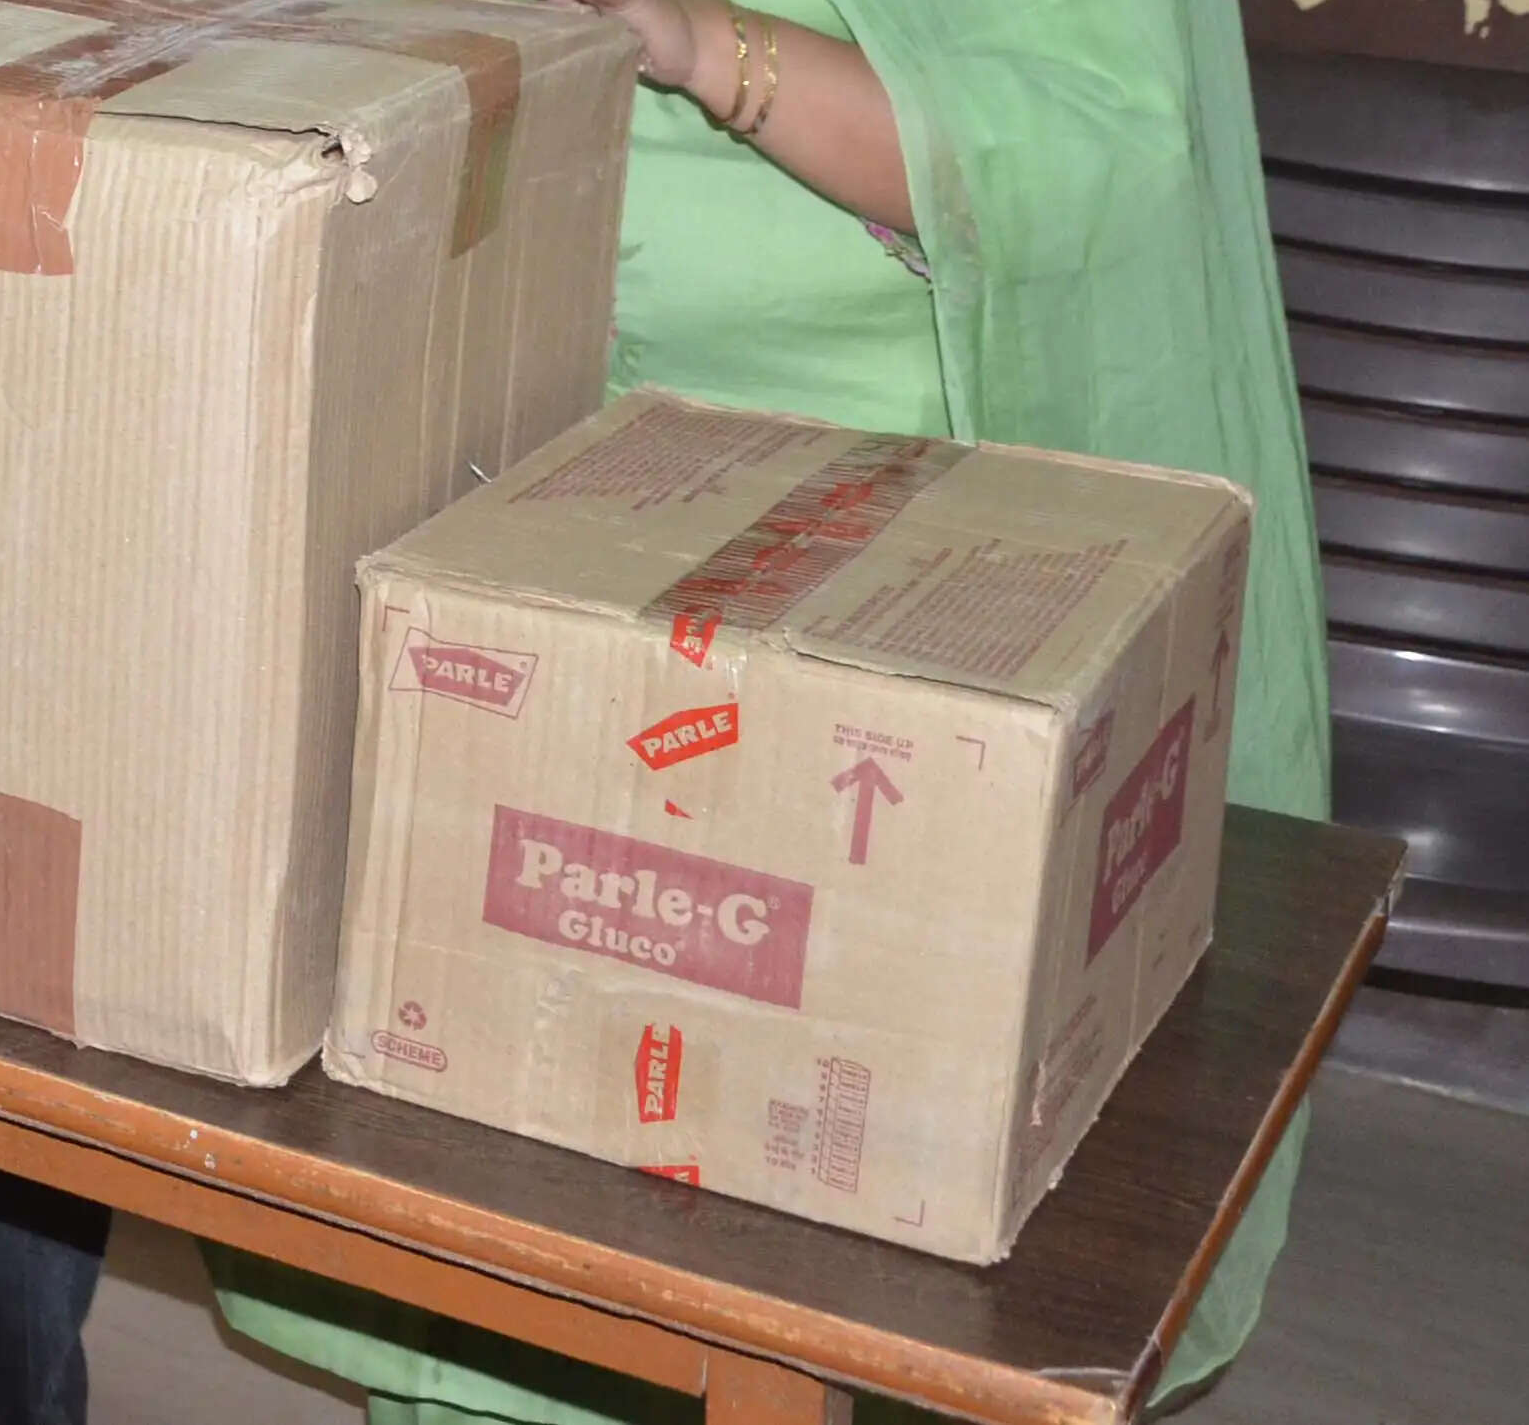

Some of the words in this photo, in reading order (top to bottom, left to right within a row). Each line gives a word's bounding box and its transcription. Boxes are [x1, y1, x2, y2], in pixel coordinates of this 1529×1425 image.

[423, 653, 514, 693] PARLE
[641, 711, 733, 759] PARLE
[516, 838, 771, 946] Parle-G
[558, 909, 677, 966] Gluco
[378, 1035, 442, 1066] SCHEME
